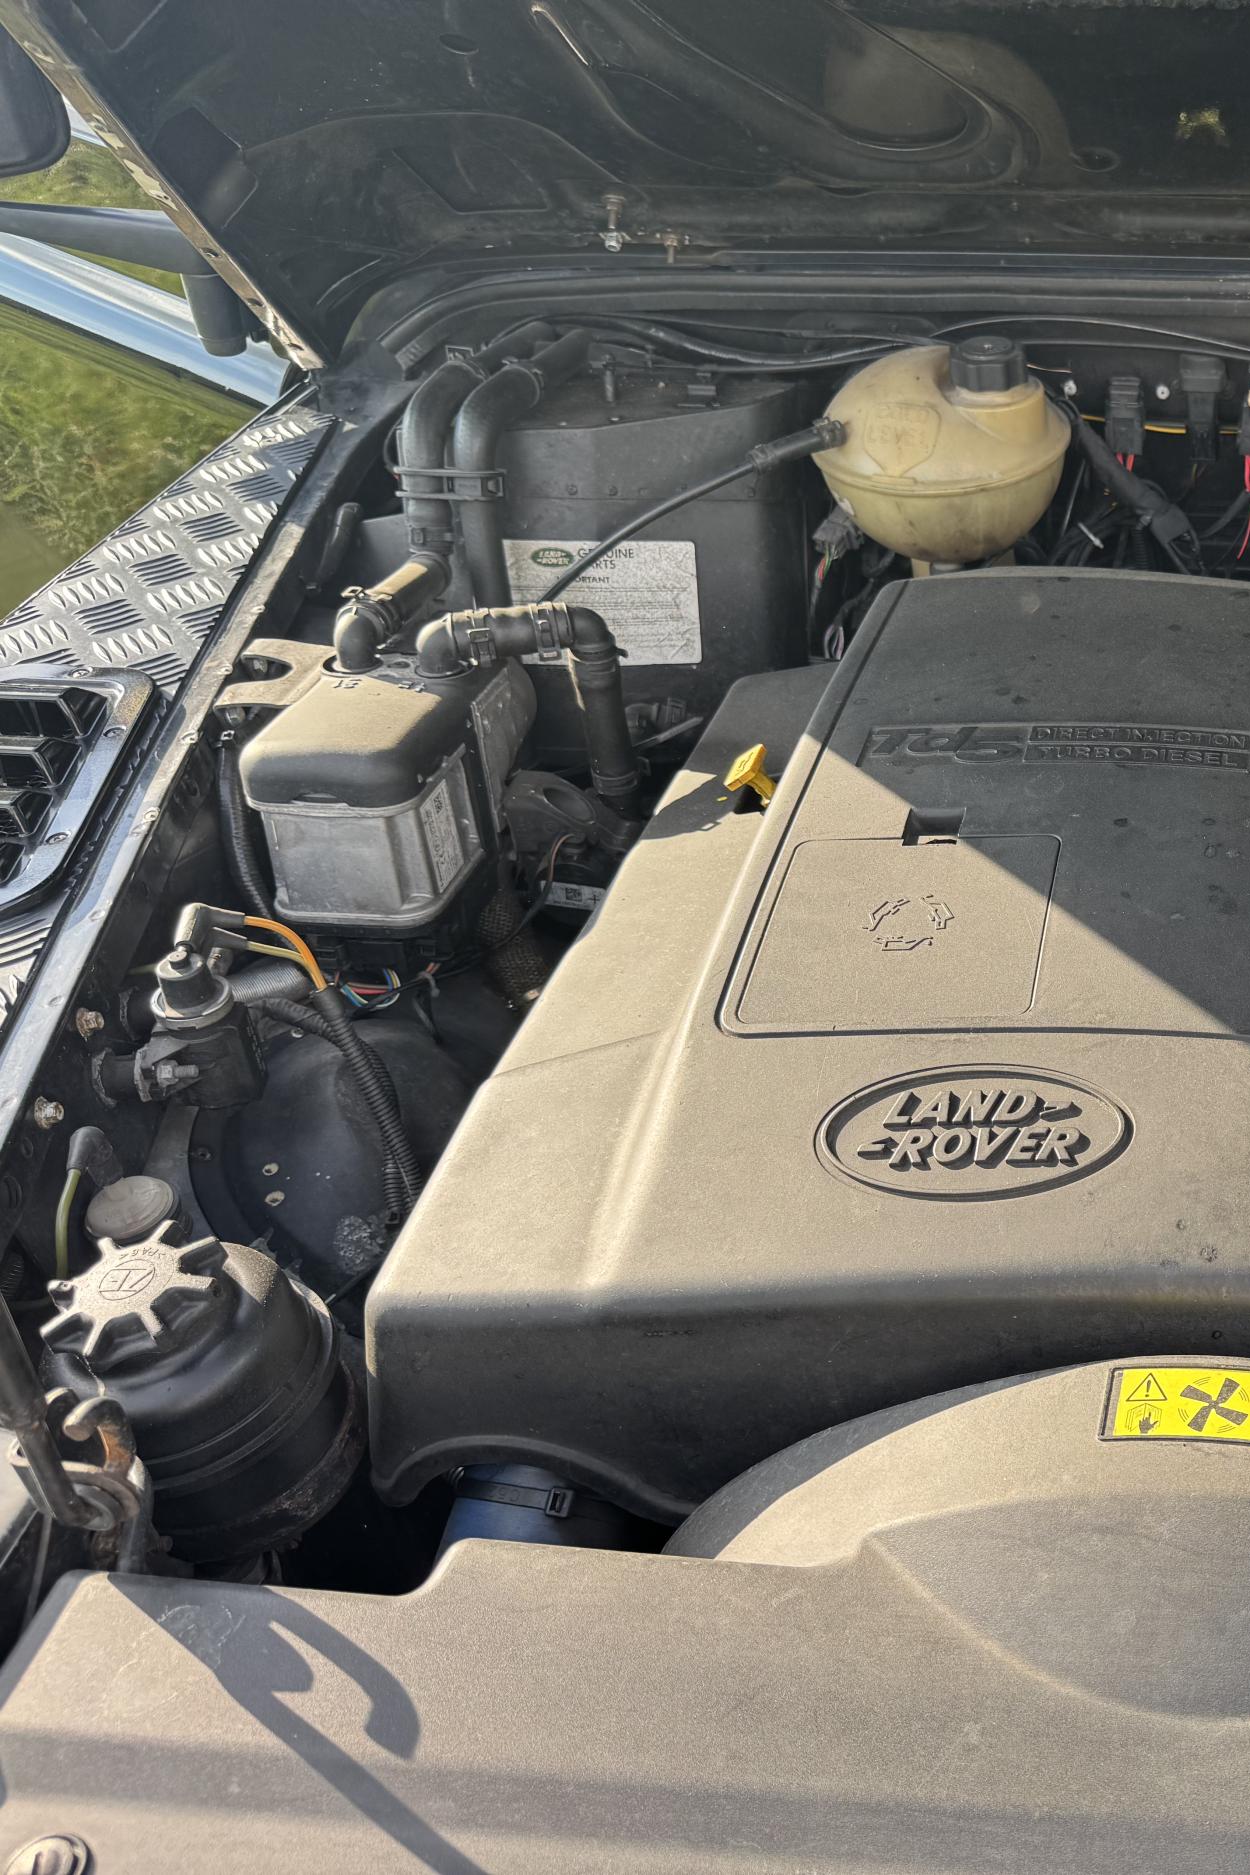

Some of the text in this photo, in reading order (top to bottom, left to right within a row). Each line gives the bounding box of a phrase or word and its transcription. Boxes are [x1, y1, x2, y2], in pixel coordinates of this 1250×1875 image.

[578, 547, 635, 559] GUINE
[1036, 726, 1120, 741] DIRECT
[1127, 728, 1247, 749] INJECTION
[1037, 745, 1238, 768] TURBO DIESEL
[883, 1088, 1044, 1132] LAND
[888, 1126, 1091, 1172] ROVER
